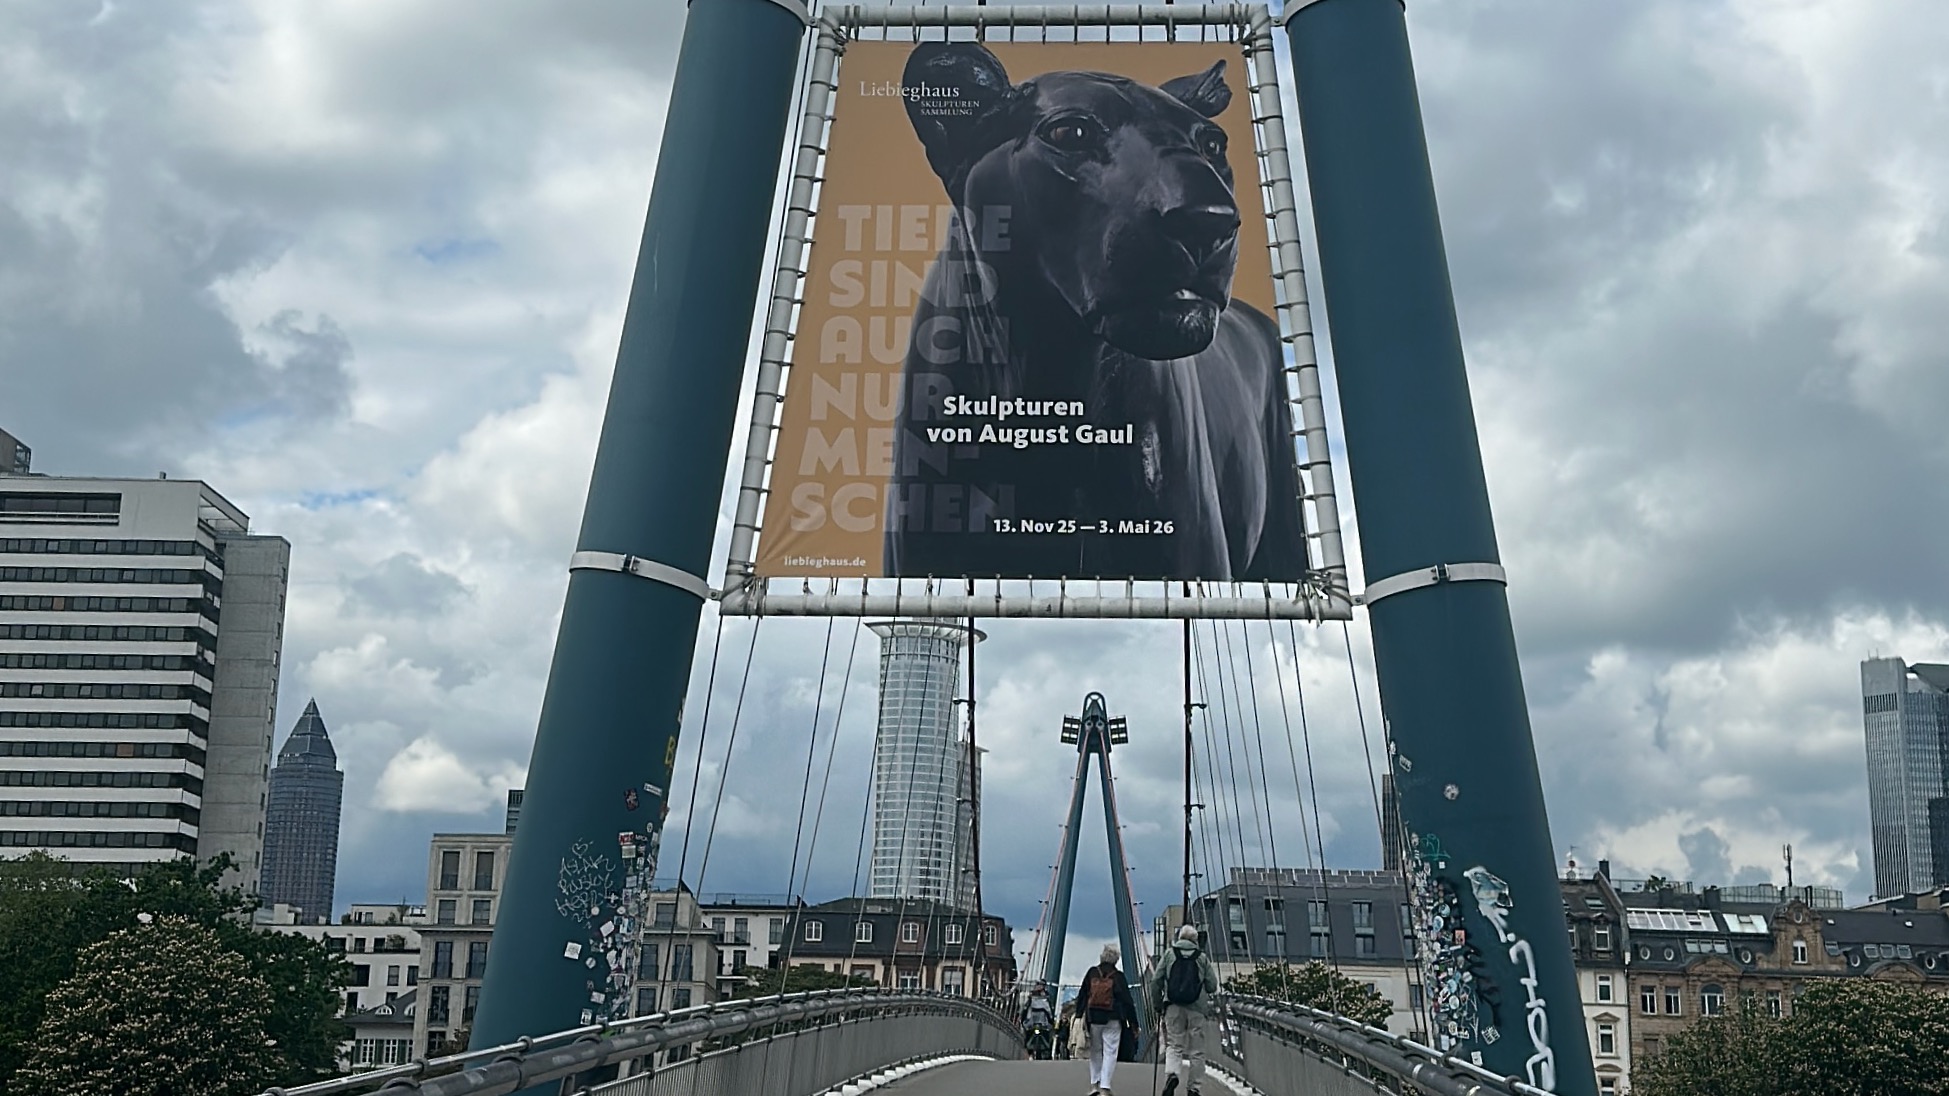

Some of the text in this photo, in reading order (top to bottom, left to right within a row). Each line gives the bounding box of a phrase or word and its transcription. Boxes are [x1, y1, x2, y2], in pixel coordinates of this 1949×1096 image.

[859, 80, 961, 102] Liebieghaus
[920, 100, 981, 108] SKULPTUREN
[920, 108, 973, 116] SAMMLUNG
[837, 204, 1013, 252] TIERE
[828, 260, 1000, 308] SIND
[819, 315, 1010, 365] AUCH
[809, 372, 955, 422] NUR
[943, 395, 1085, 421] Skulpturen
[926, 424, 1134, 449] von August Gaul
[797, 427, 981, 477] MEN-
[790, 482, 1017, 533] SCHEN
[993, 519, 1017, 533] 13.
[1020, 519, 1054, 533] Nov
[1057, 520, 1077, 533] 25
[1099, 520, 1115, 534] 3.
[1118, 520, 1150, 534] Mai
[1153, 520, 1175, 534] 26
[783, 555, 867, 569] liebieghaus.de
